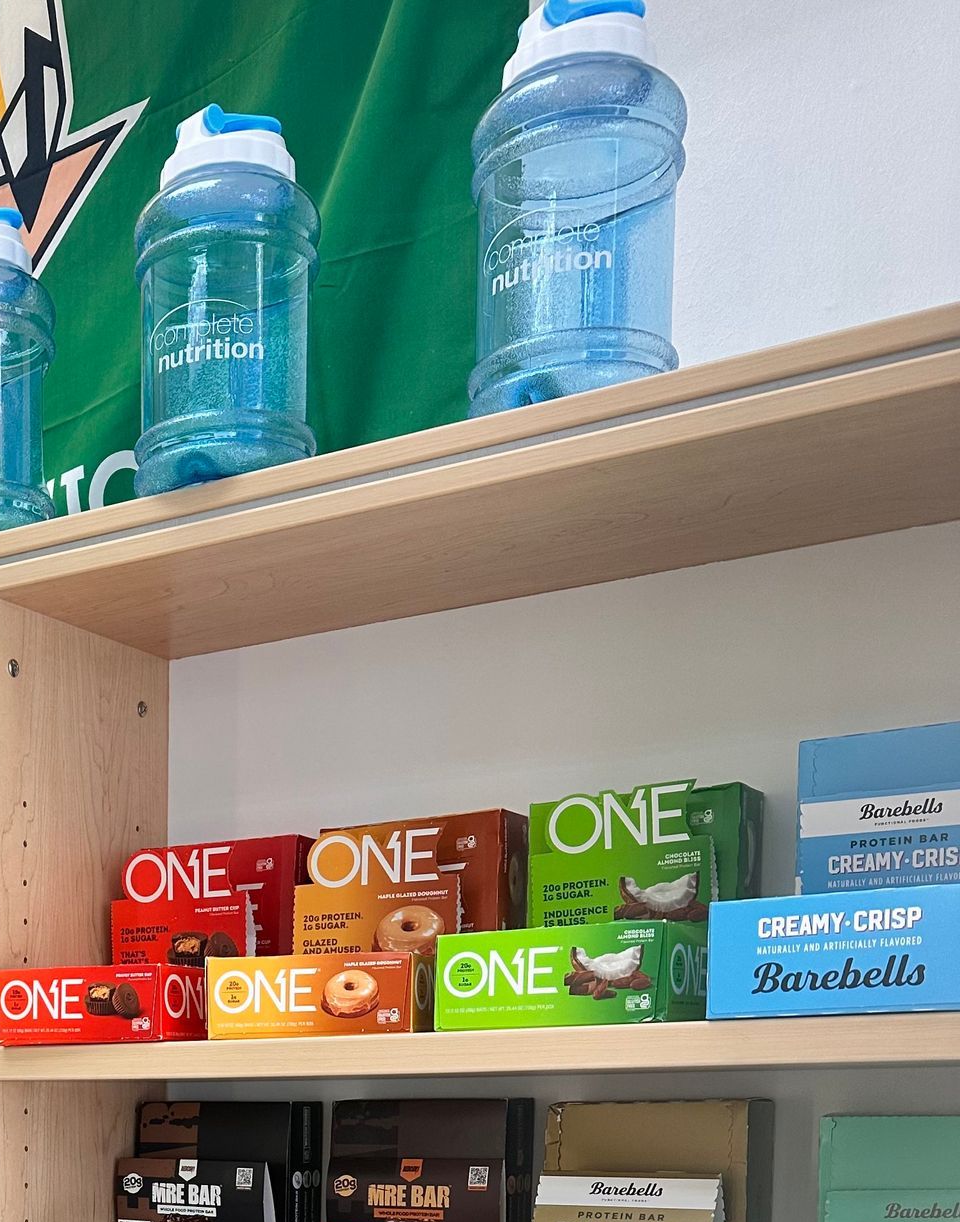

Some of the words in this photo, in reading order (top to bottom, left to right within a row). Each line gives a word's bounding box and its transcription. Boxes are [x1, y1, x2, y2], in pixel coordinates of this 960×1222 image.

[491, 247, 612, 296] nutrition
[153, 314, 254, 353] complete
[157, 338, 264, 374] nutrition
[548, 783, 691, 854] ONE
[859, 798, 943, 821] Barebells
[850, 836, 913, 849] PROTEIN
[920, 833, 949, 842] BAR
[311, 828, 440, 888] ONE
[665, 851, 700, 859] CHOCOLATE
[125, 845, 231, 903] ONE
[827, 878, 867, 889] NATURALLY
[869, 876, 884, 886] AND
[886, 874, 933, 885] ARTIFICIALLY
[544, 905, 608, 919] INDULGENCE
[303, 939, 337, 947] GLAZED
[757, 944, 801, 955] NATURALLY
[804, 943, 820, 952] AND
[823, 938, 876, 951] ARTIFICIALLY
[880, 936, 922, 948] FLAVORED
[443, 946, 561, 998] ONE
[752, 954, 926, 995] Barebells
[0, 978, 86, 1020] ONE
[214, 968, 318, 1014] ONE
[152, 1183, 186, 1205] MRE
[188, 1185, 221, 1206] BAR
[368, 1184, 408, 1207] MRE
[410, 1185, 451, 1208] BAR
[589, 1182, 663, 1197] Barebells
[578, 1211, 633, 1221] PROTEIN
[639, 1213, 665, 1221] BAR
